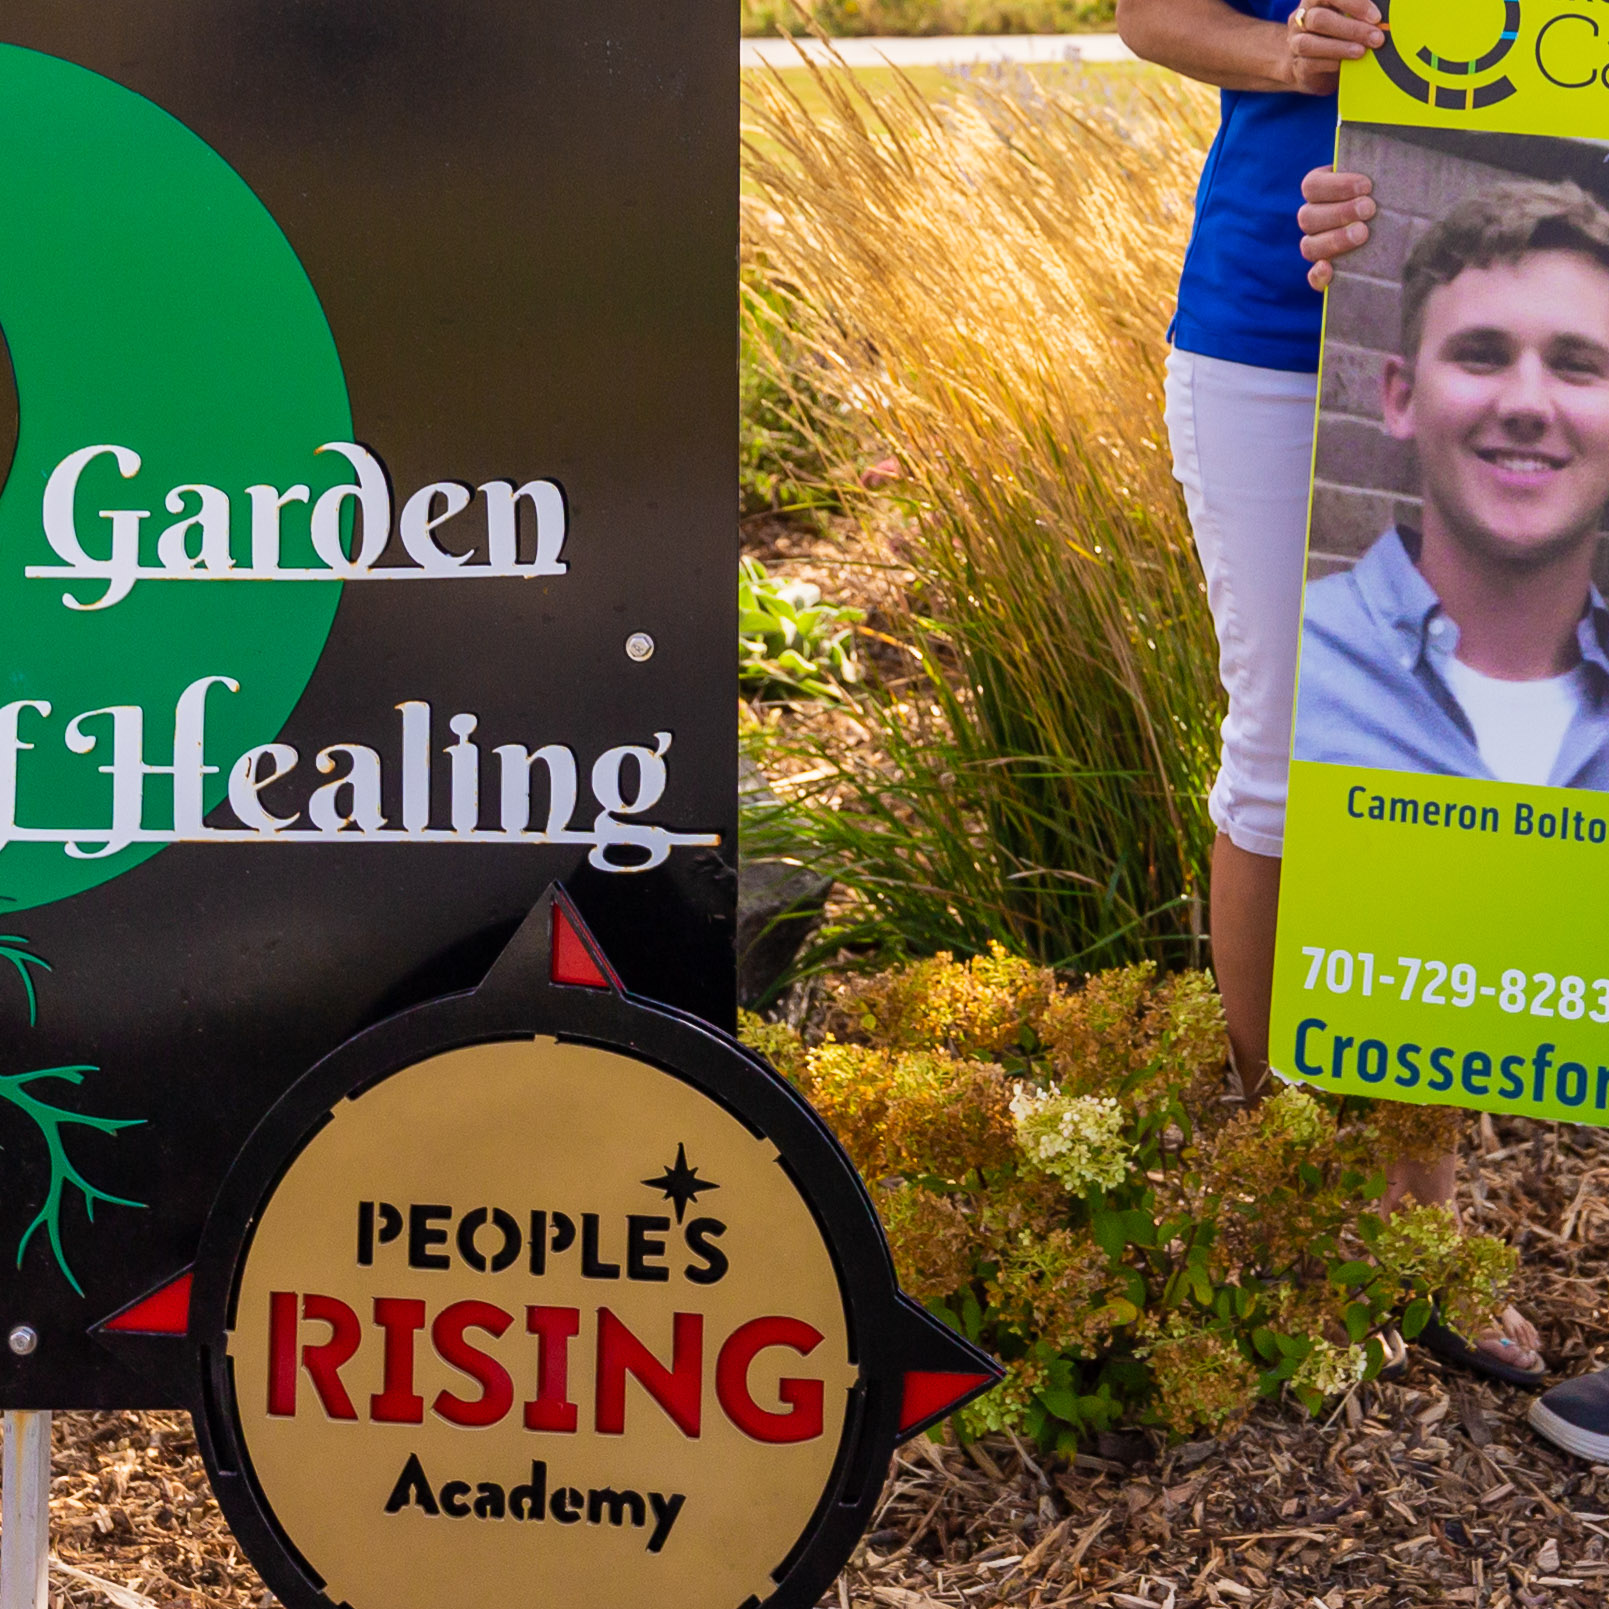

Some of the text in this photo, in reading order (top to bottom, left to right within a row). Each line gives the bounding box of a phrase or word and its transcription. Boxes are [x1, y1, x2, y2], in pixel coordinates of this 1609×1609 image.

[25, 442, 567, 611] Garden
[63, 675, 676, 872] Healing
[1346, 785, 1501, 837] Cameron
[267, 1291, 825, 1444] RISING
[386, 1453, 685, 1553] Academy
